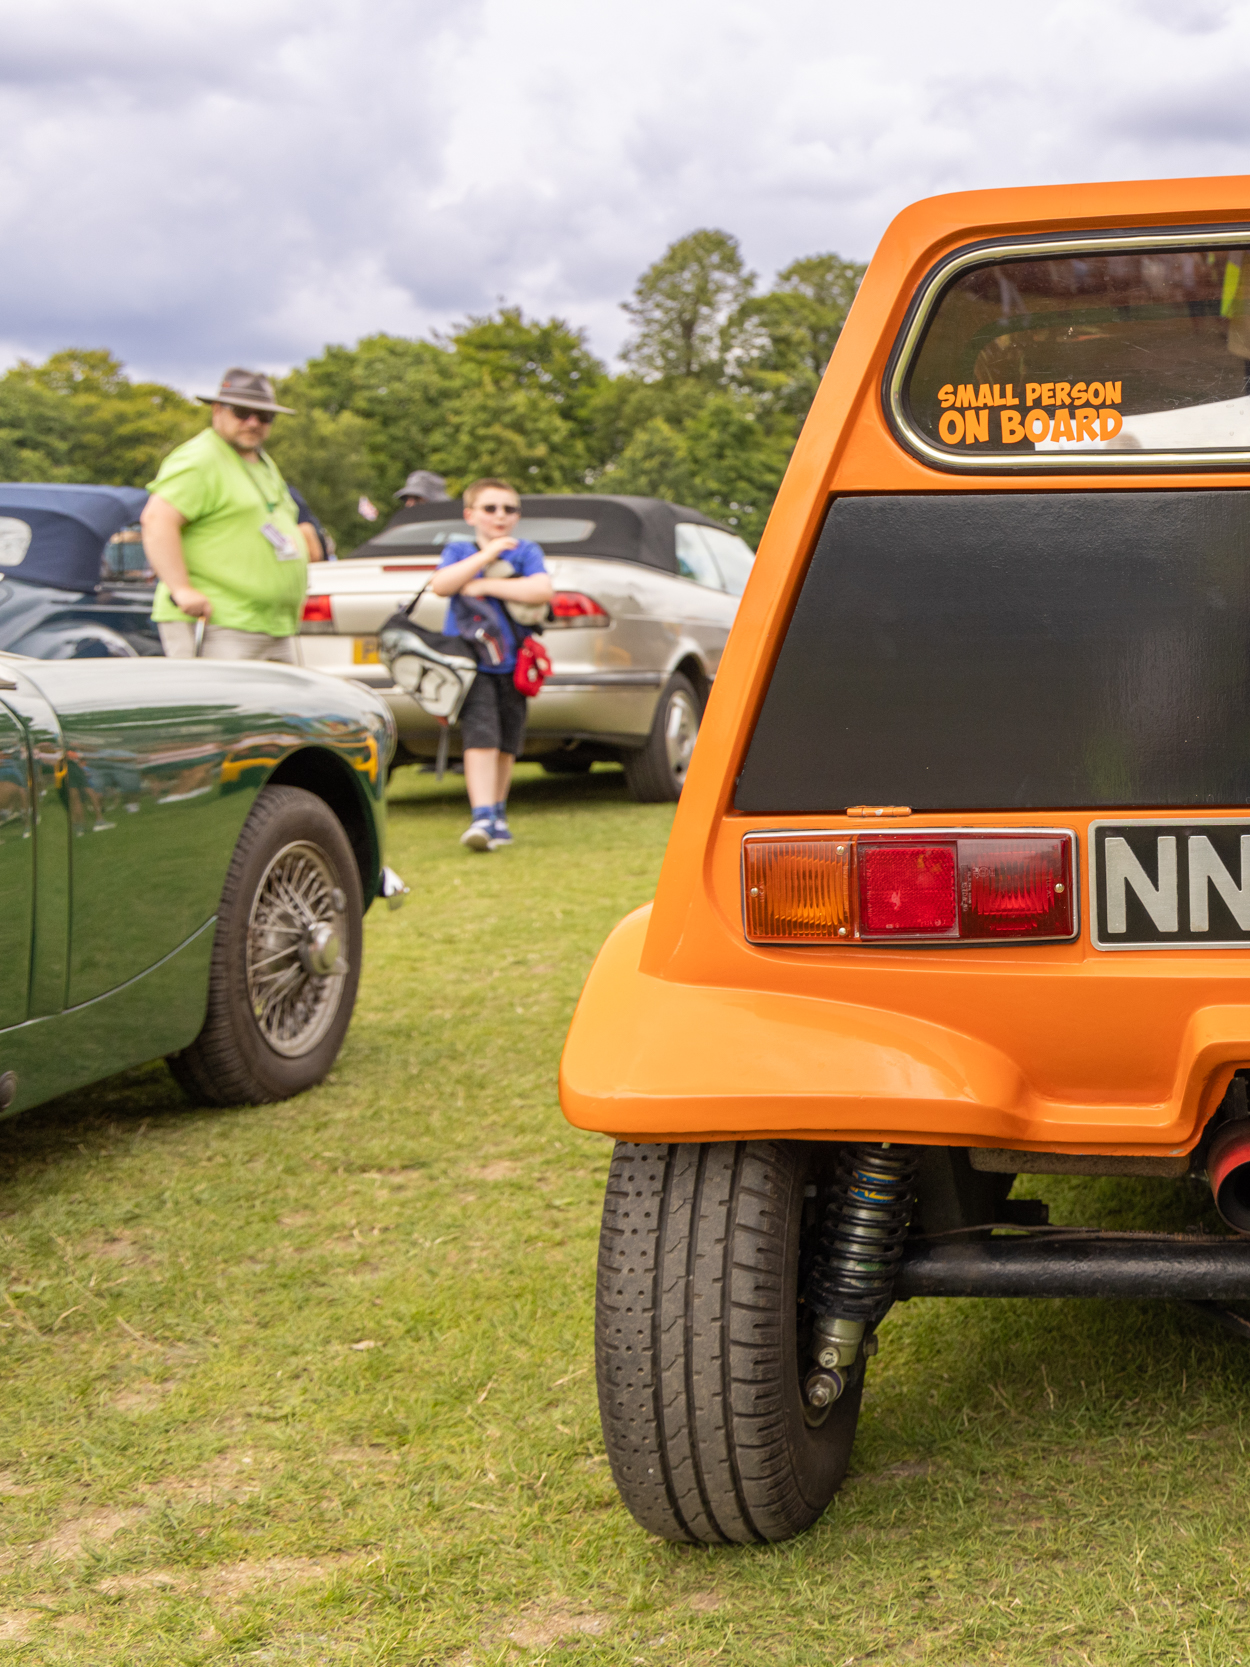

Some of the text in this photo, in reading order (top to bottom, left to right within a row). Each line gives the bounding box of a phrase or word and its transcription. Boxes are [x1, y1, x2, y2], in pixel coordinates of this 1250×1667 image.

[937, 380, 1122, 409] SMALL PERSON
[938, 408, 1123, 446] ON BOARD
